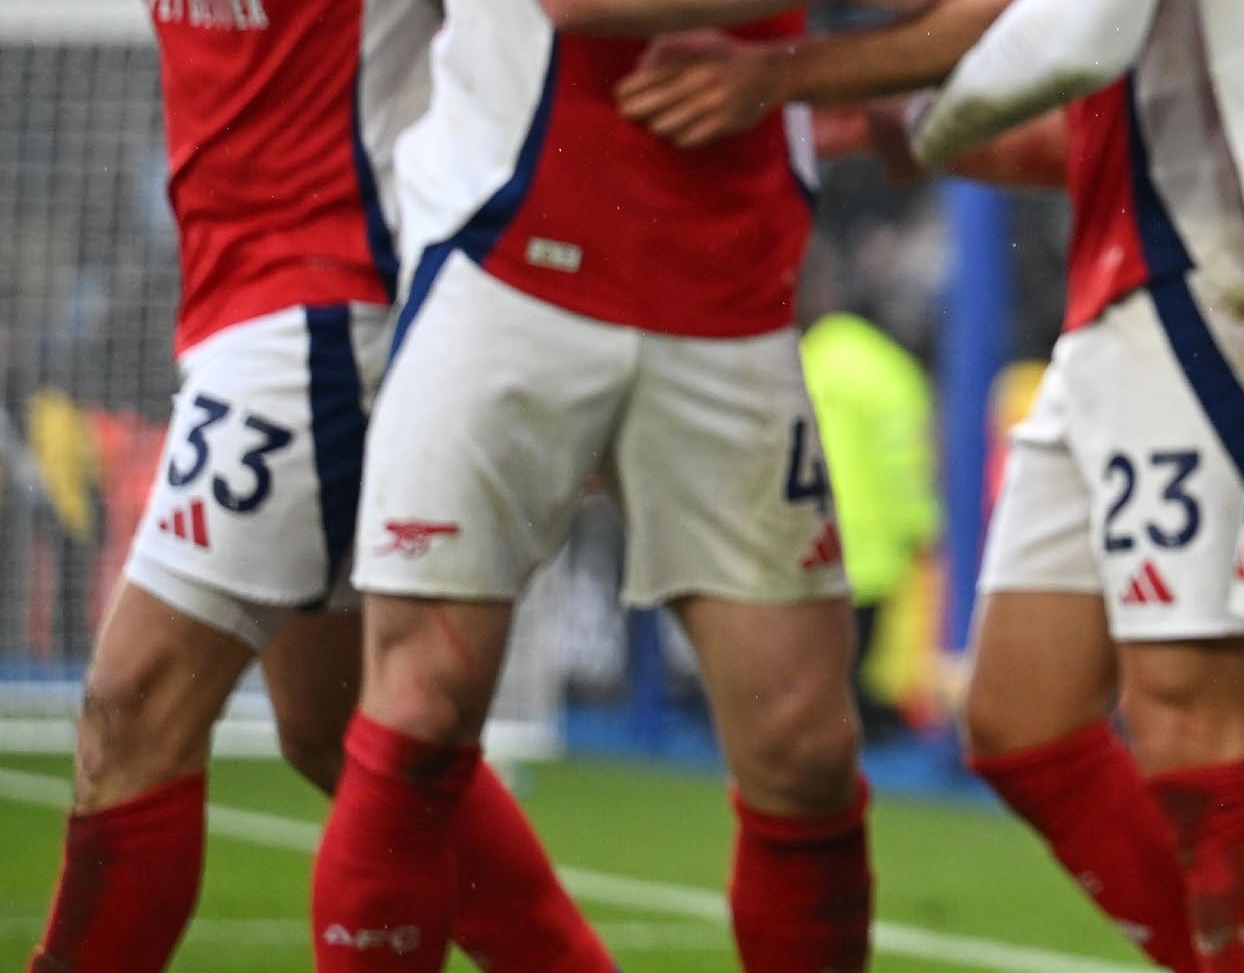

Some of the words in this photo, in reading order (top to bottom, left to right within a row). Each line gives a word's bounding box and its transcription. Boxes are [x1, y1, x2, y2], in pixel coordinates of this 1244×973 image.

[168, 394, 293, 514] 33
[785, 414, 833, 514] 4
[1103, 451, 1203, 552] 23
